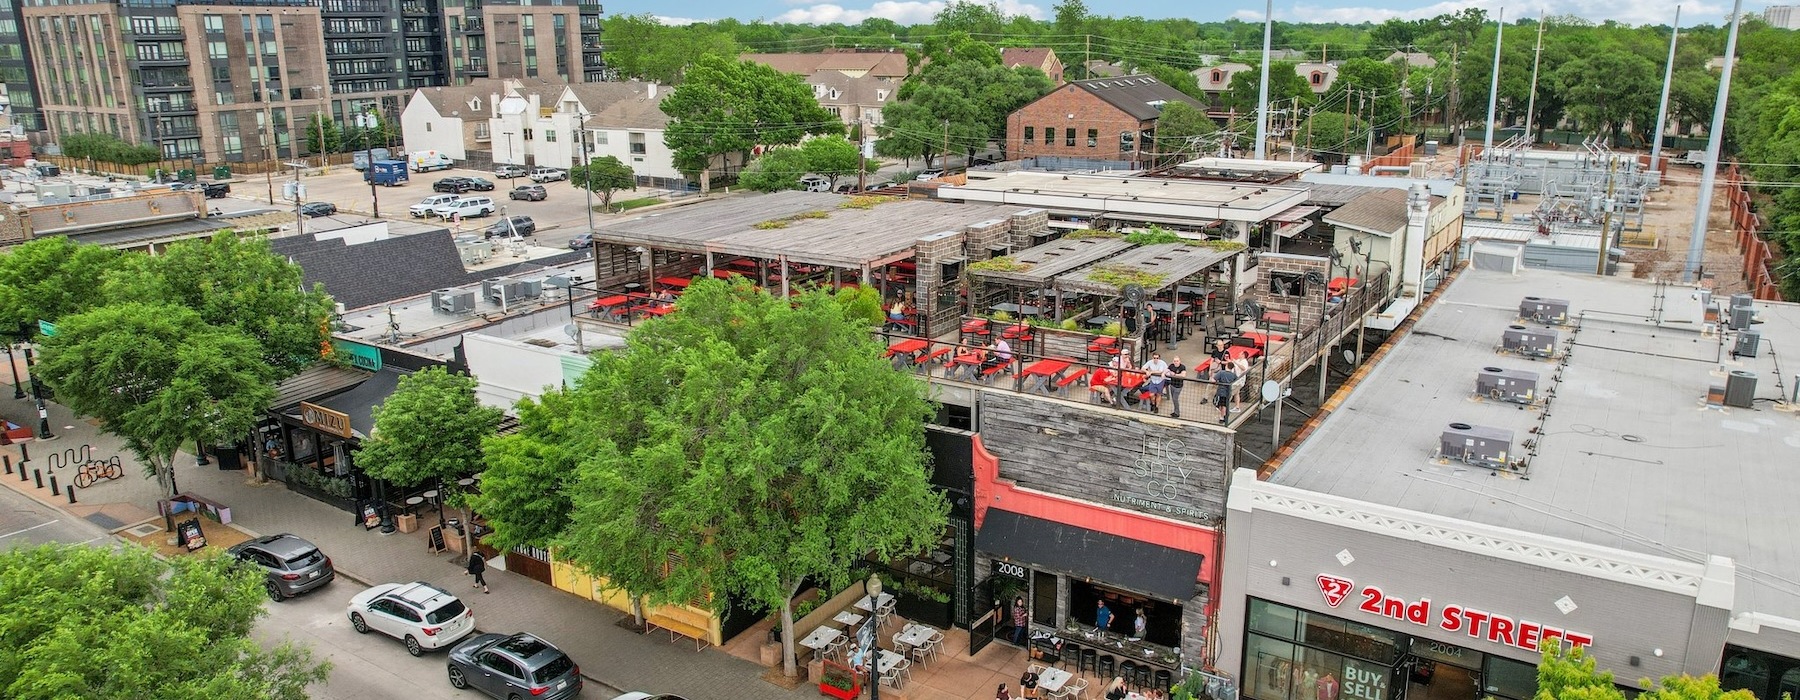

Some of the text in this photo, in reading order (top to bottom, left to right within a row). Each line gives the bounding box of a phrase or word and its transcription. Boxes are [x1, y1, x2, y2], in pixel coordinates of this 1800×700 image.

[314, 410, 346, 431] MIZU
[1142, 434, 1187, 463] HG
[1134, 458, 1194, 485] SPLY
[1147, 480, 1177, 500] CO
[1113, 493, 1209, 520] NUTRIMENT & SPIRITS
[998, 562, 1024, 578] 2008
[1359, 585, 1432, 626] 2nd
[1430, 642, 1462, 658] 2004
[1345, 666, 1382, 686] BUY
